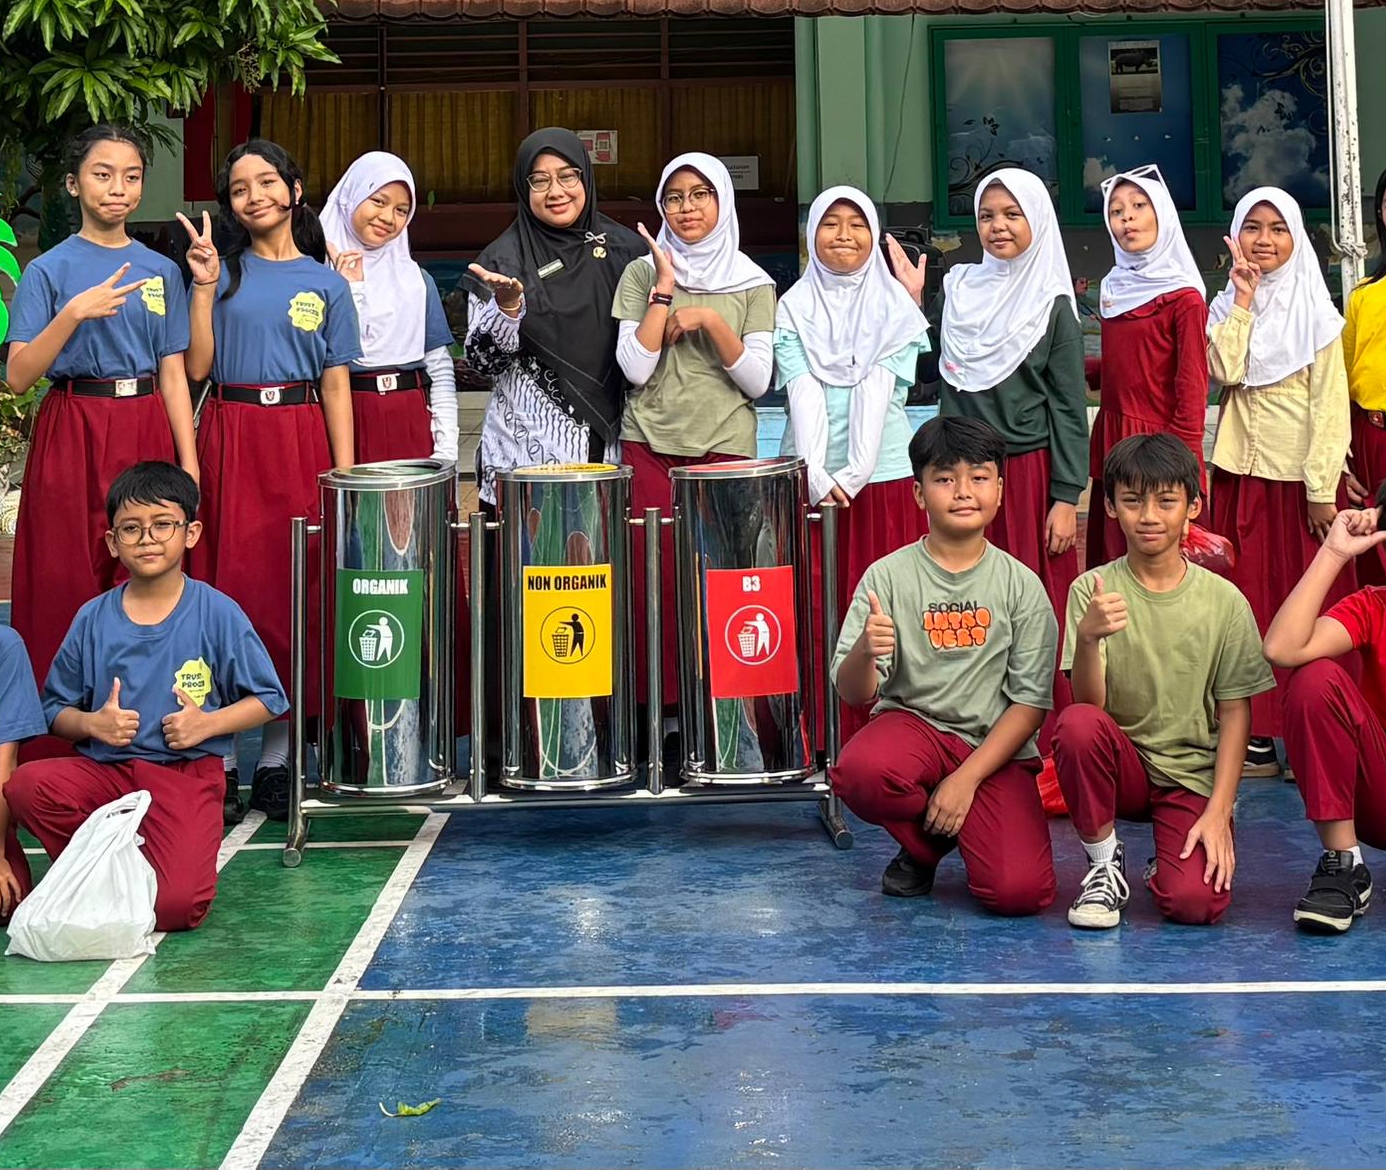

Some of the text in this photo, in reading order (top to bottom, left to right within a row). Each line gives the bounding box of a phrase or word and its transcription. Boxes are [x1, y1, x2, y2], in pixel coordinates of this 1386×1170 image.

[352, 578, 409, 595] ORGANIK
[527, 573, 607, 591] NON ORGANIK
[742, 575, 761, 592] B3
[928, 600, 978, 612] SOCIAL
